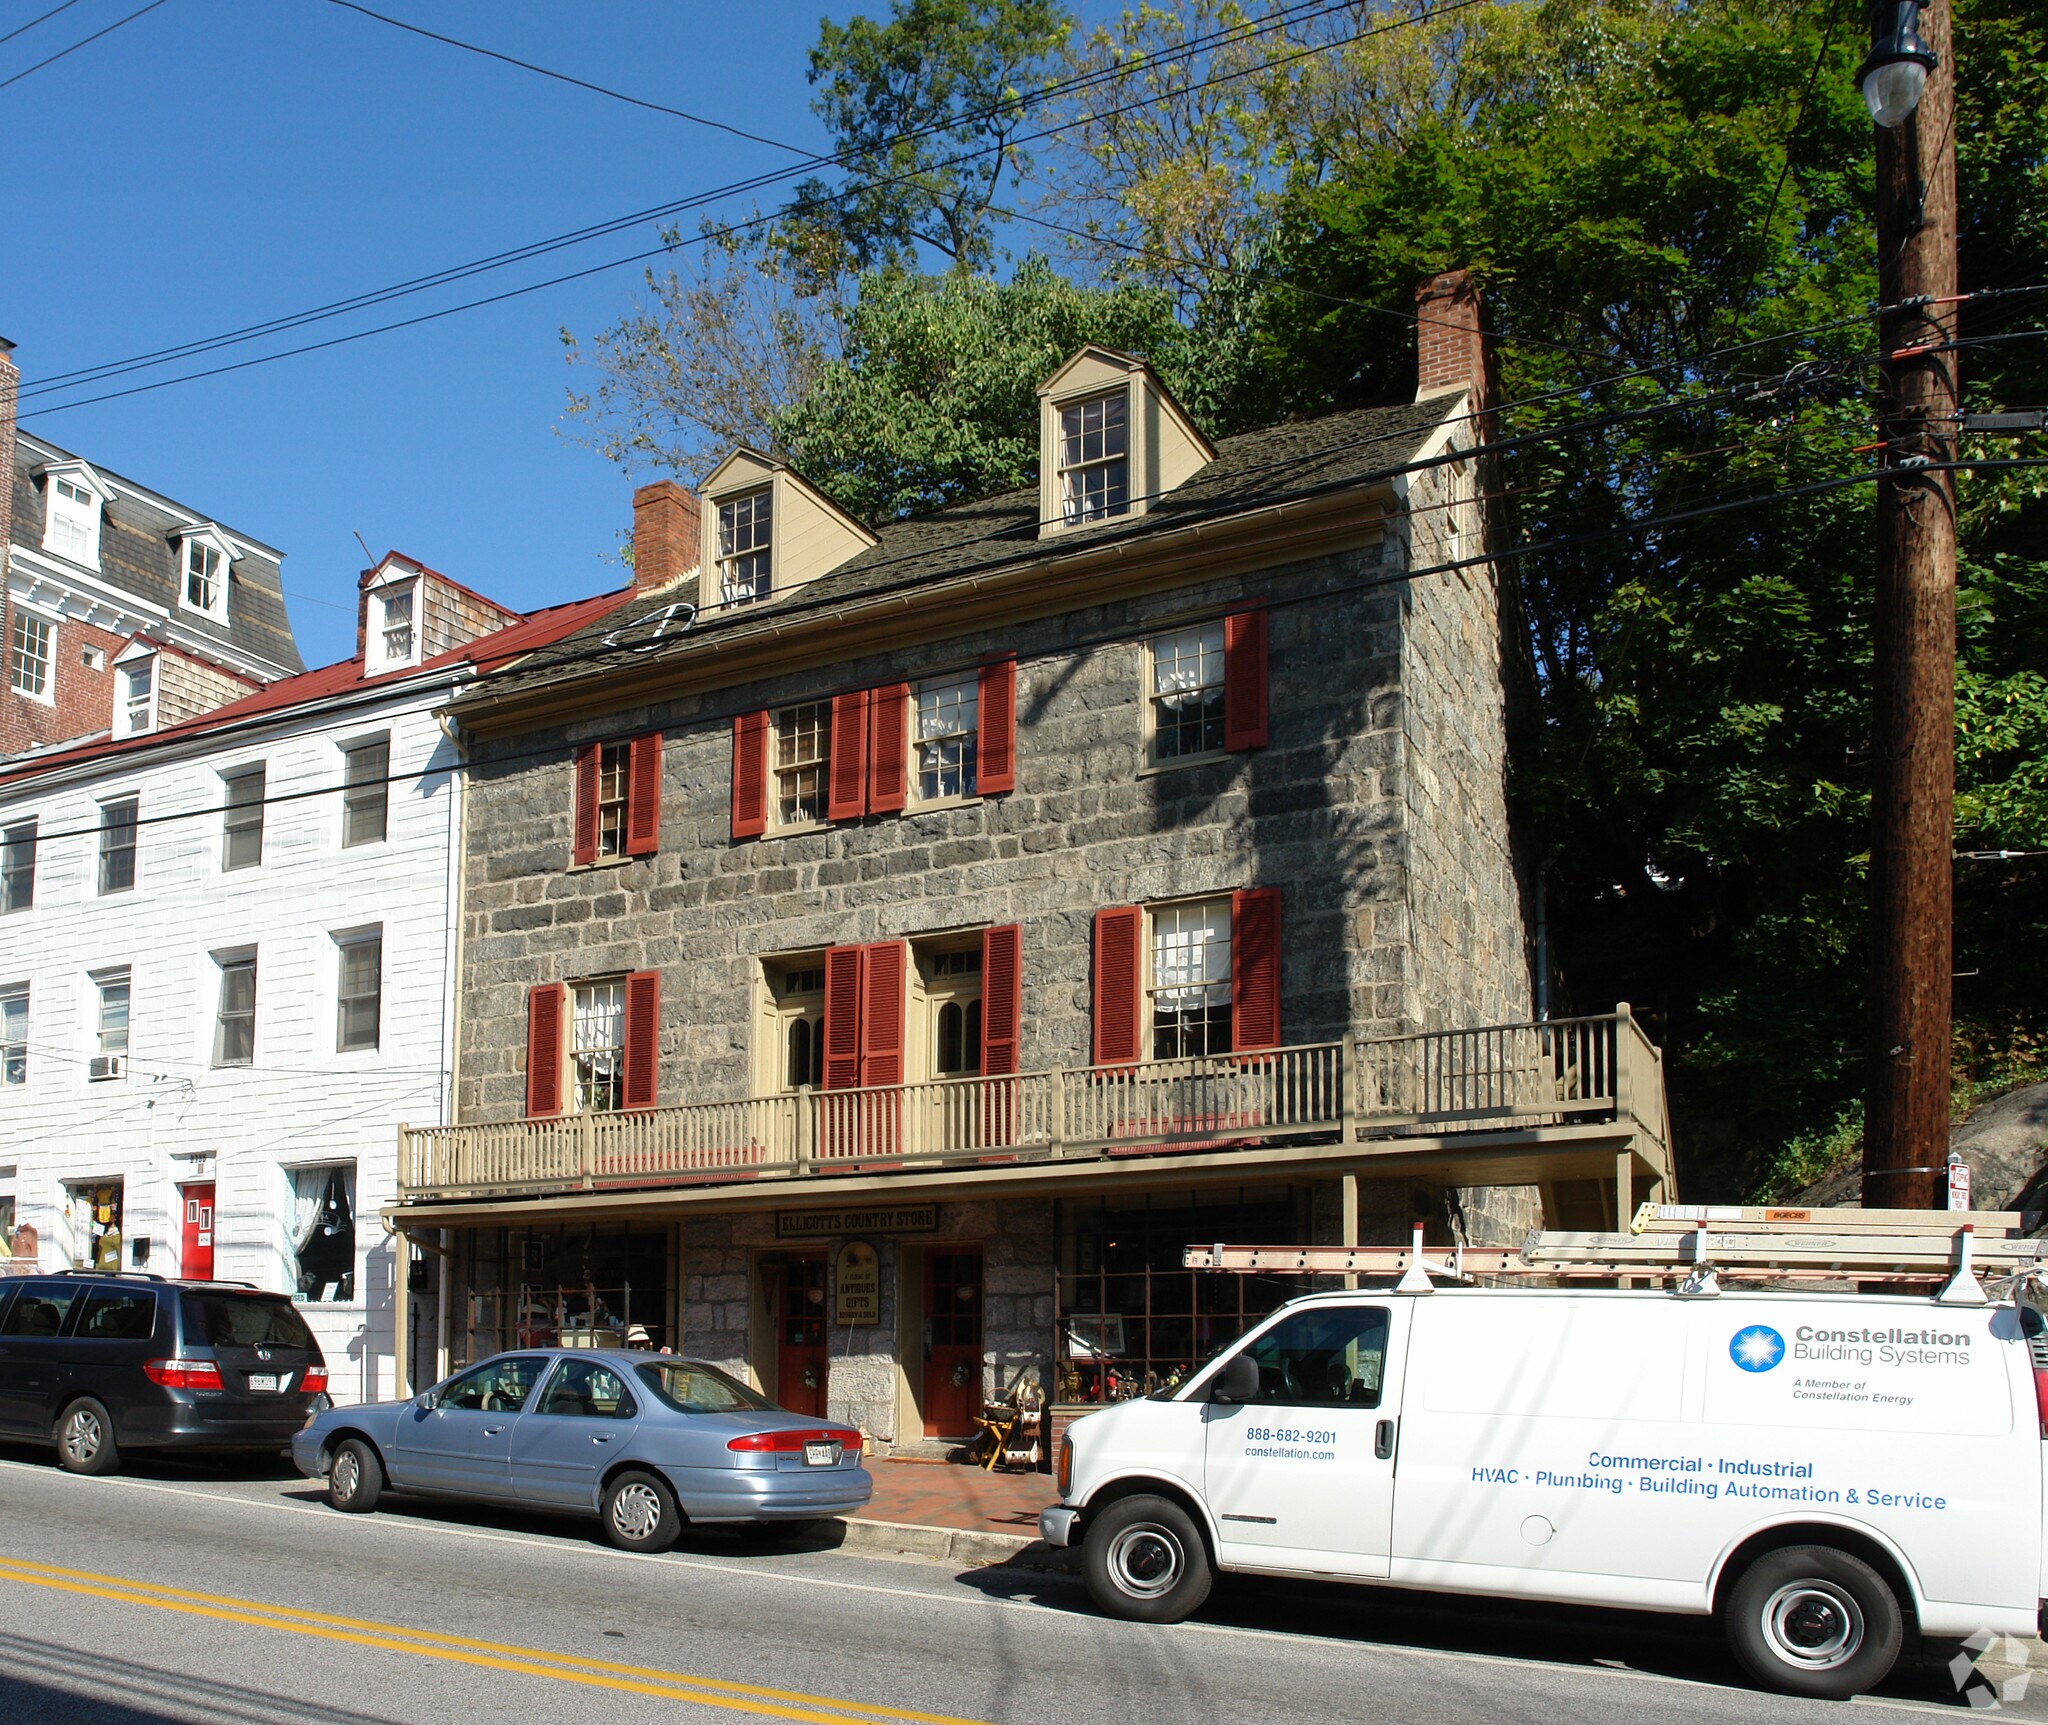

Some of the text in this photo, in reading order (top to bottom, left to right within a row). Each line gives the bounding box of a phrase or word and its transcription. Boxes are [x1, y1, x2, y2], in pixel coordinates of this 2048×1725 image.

[844, 1211, 894, 1229] COUNTRY
[896, 1209, 933, 1226] STORE
[840, 1282, 876, 1294] ANTIQUES
[845, 1296, 870, 1308] GIFTS
[1795, 1325, 1971, 1346] Constellation
[1794, 1343, 1970, 1367] Building Systems
[1793, 1379, 1868, 1390] A Member of
[1793, 1390, 1914, 1406] Constellation Energy
[1246, 1427, 1337, 1444] 888-682-9201
[1245, 1447, 1335, 1460] constellation.com
[1589, 1452, 1813, 1479] Commercial Industrial
[1472, 1467, 1947, 1510] HVAC Plumbing Building Automation & Service
